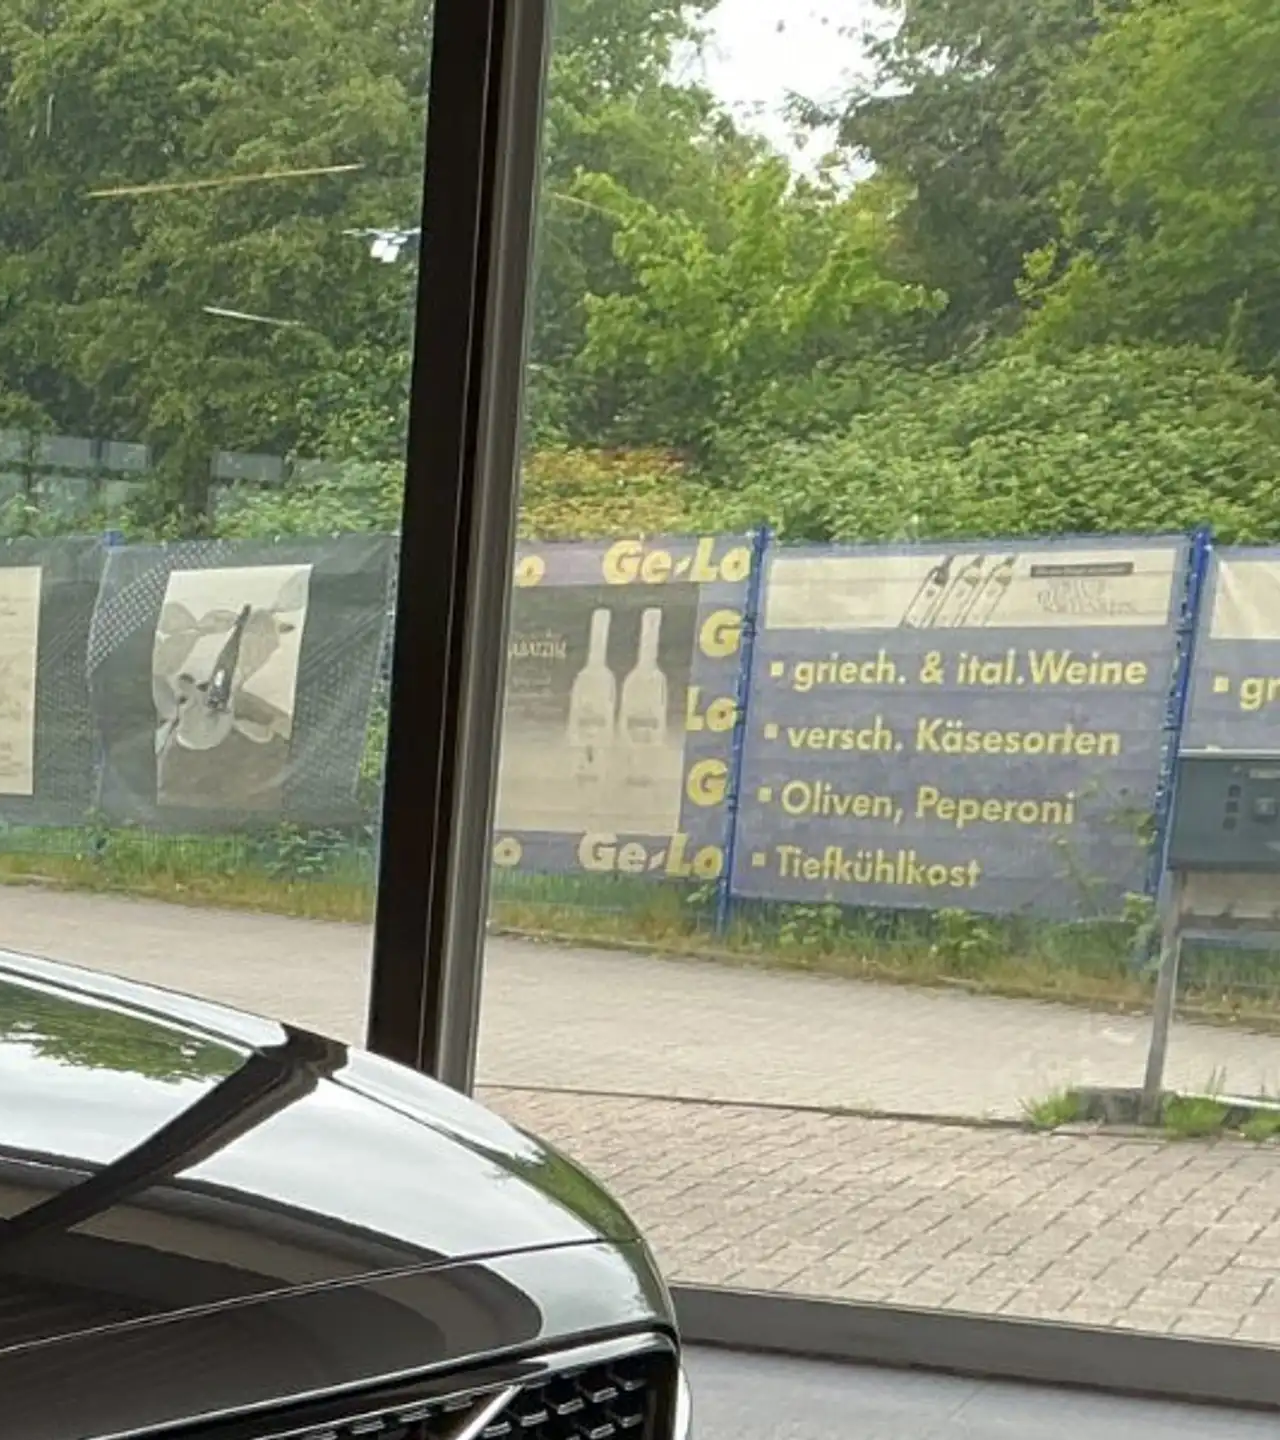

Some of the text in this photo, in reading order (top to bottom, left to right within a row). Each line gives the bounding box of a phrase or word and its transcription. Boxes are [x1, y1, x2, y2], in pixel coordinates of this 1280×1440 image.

[792, 649, 907, 692] griech.
[919, 651, 945, 685] &
[786, 715, 1121, 756] versch. Käsesorten
[780, 780, 1075, 830] Oliven, Peperoni
[775, 845, 983, 888] Tiefkühlkost
